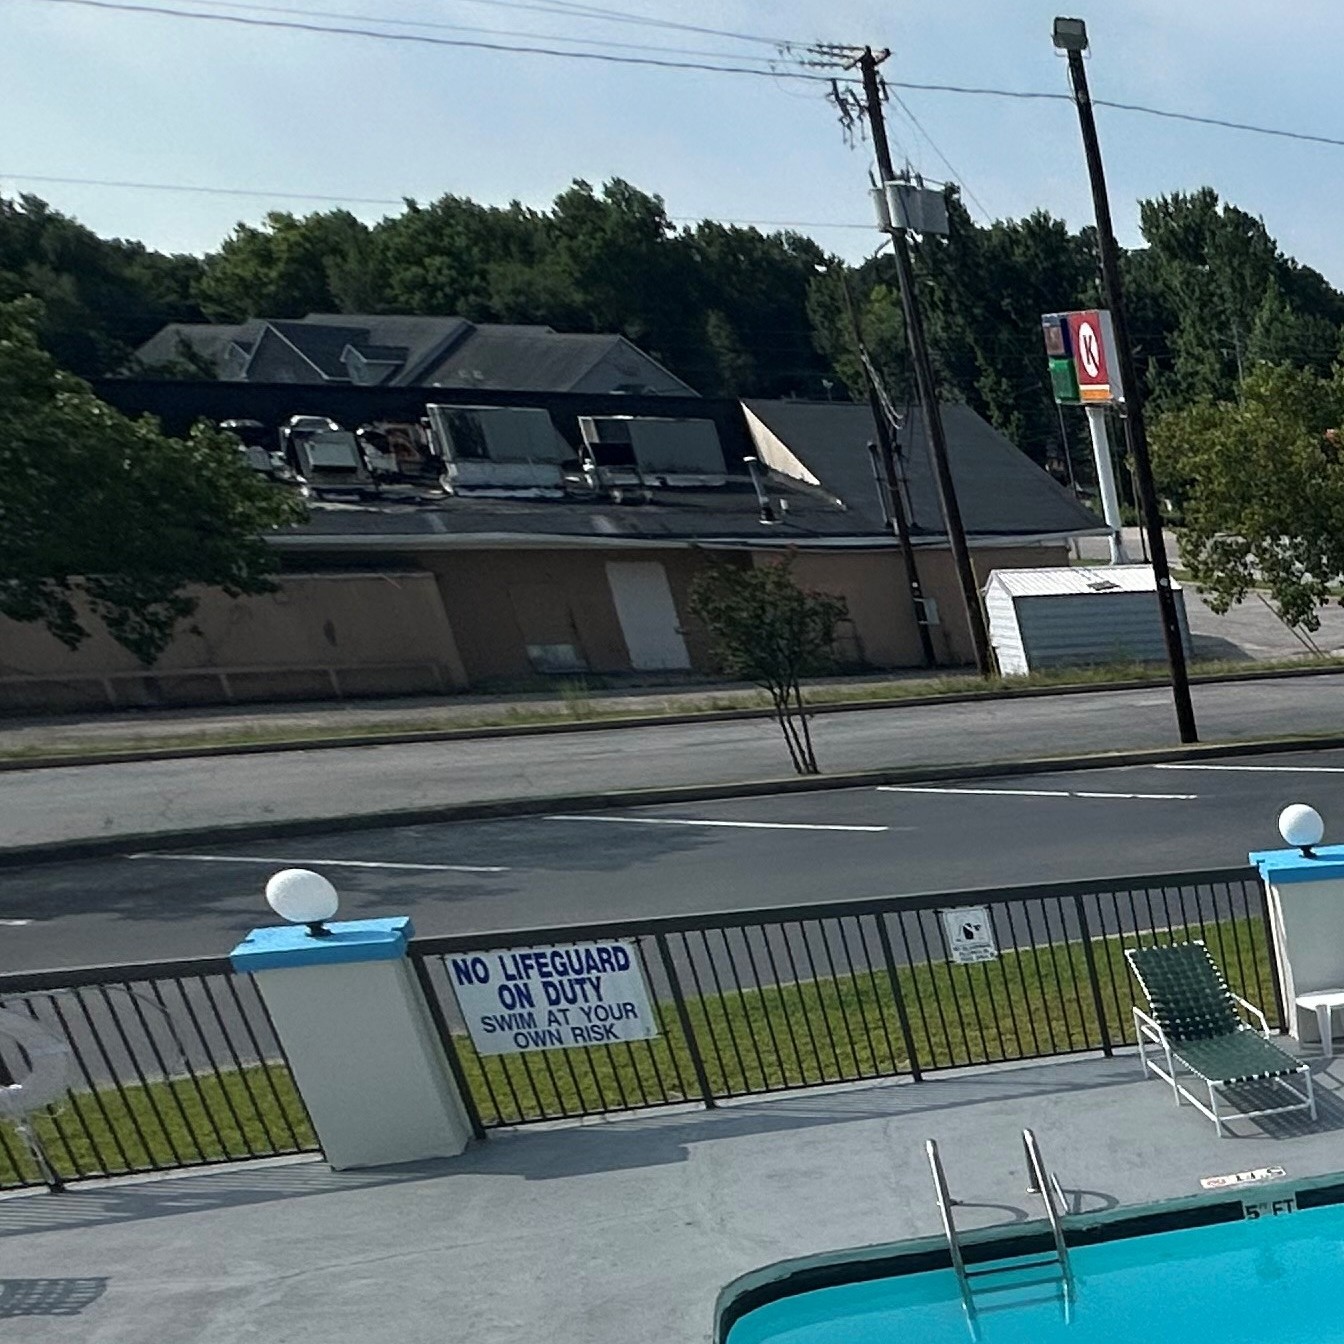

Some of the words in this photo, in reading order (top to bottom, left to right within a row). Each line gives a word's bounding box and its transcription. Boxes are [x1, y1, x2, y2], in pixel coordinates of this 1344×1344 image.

[1082, 334, 1100, 371] K
[452, 957, 490, 985] NO
[498, 946, 630, 982] LIFEGUARD
[498, 983, 534, 1010] ON
[543, 976, 603, 1006] DUTY
[480, 1012, 537, 1033] SWIM
[547, 1009, 570, 1027] AT
[580, 1002, 638, 1024] YOUR
[514, 1030, 564, 1049] OWN
[573, 1024, 620, 1044] RISK
[1245, 1204, 1260, 1219] 5
[1272, 1199, 1294, 1216] FT
